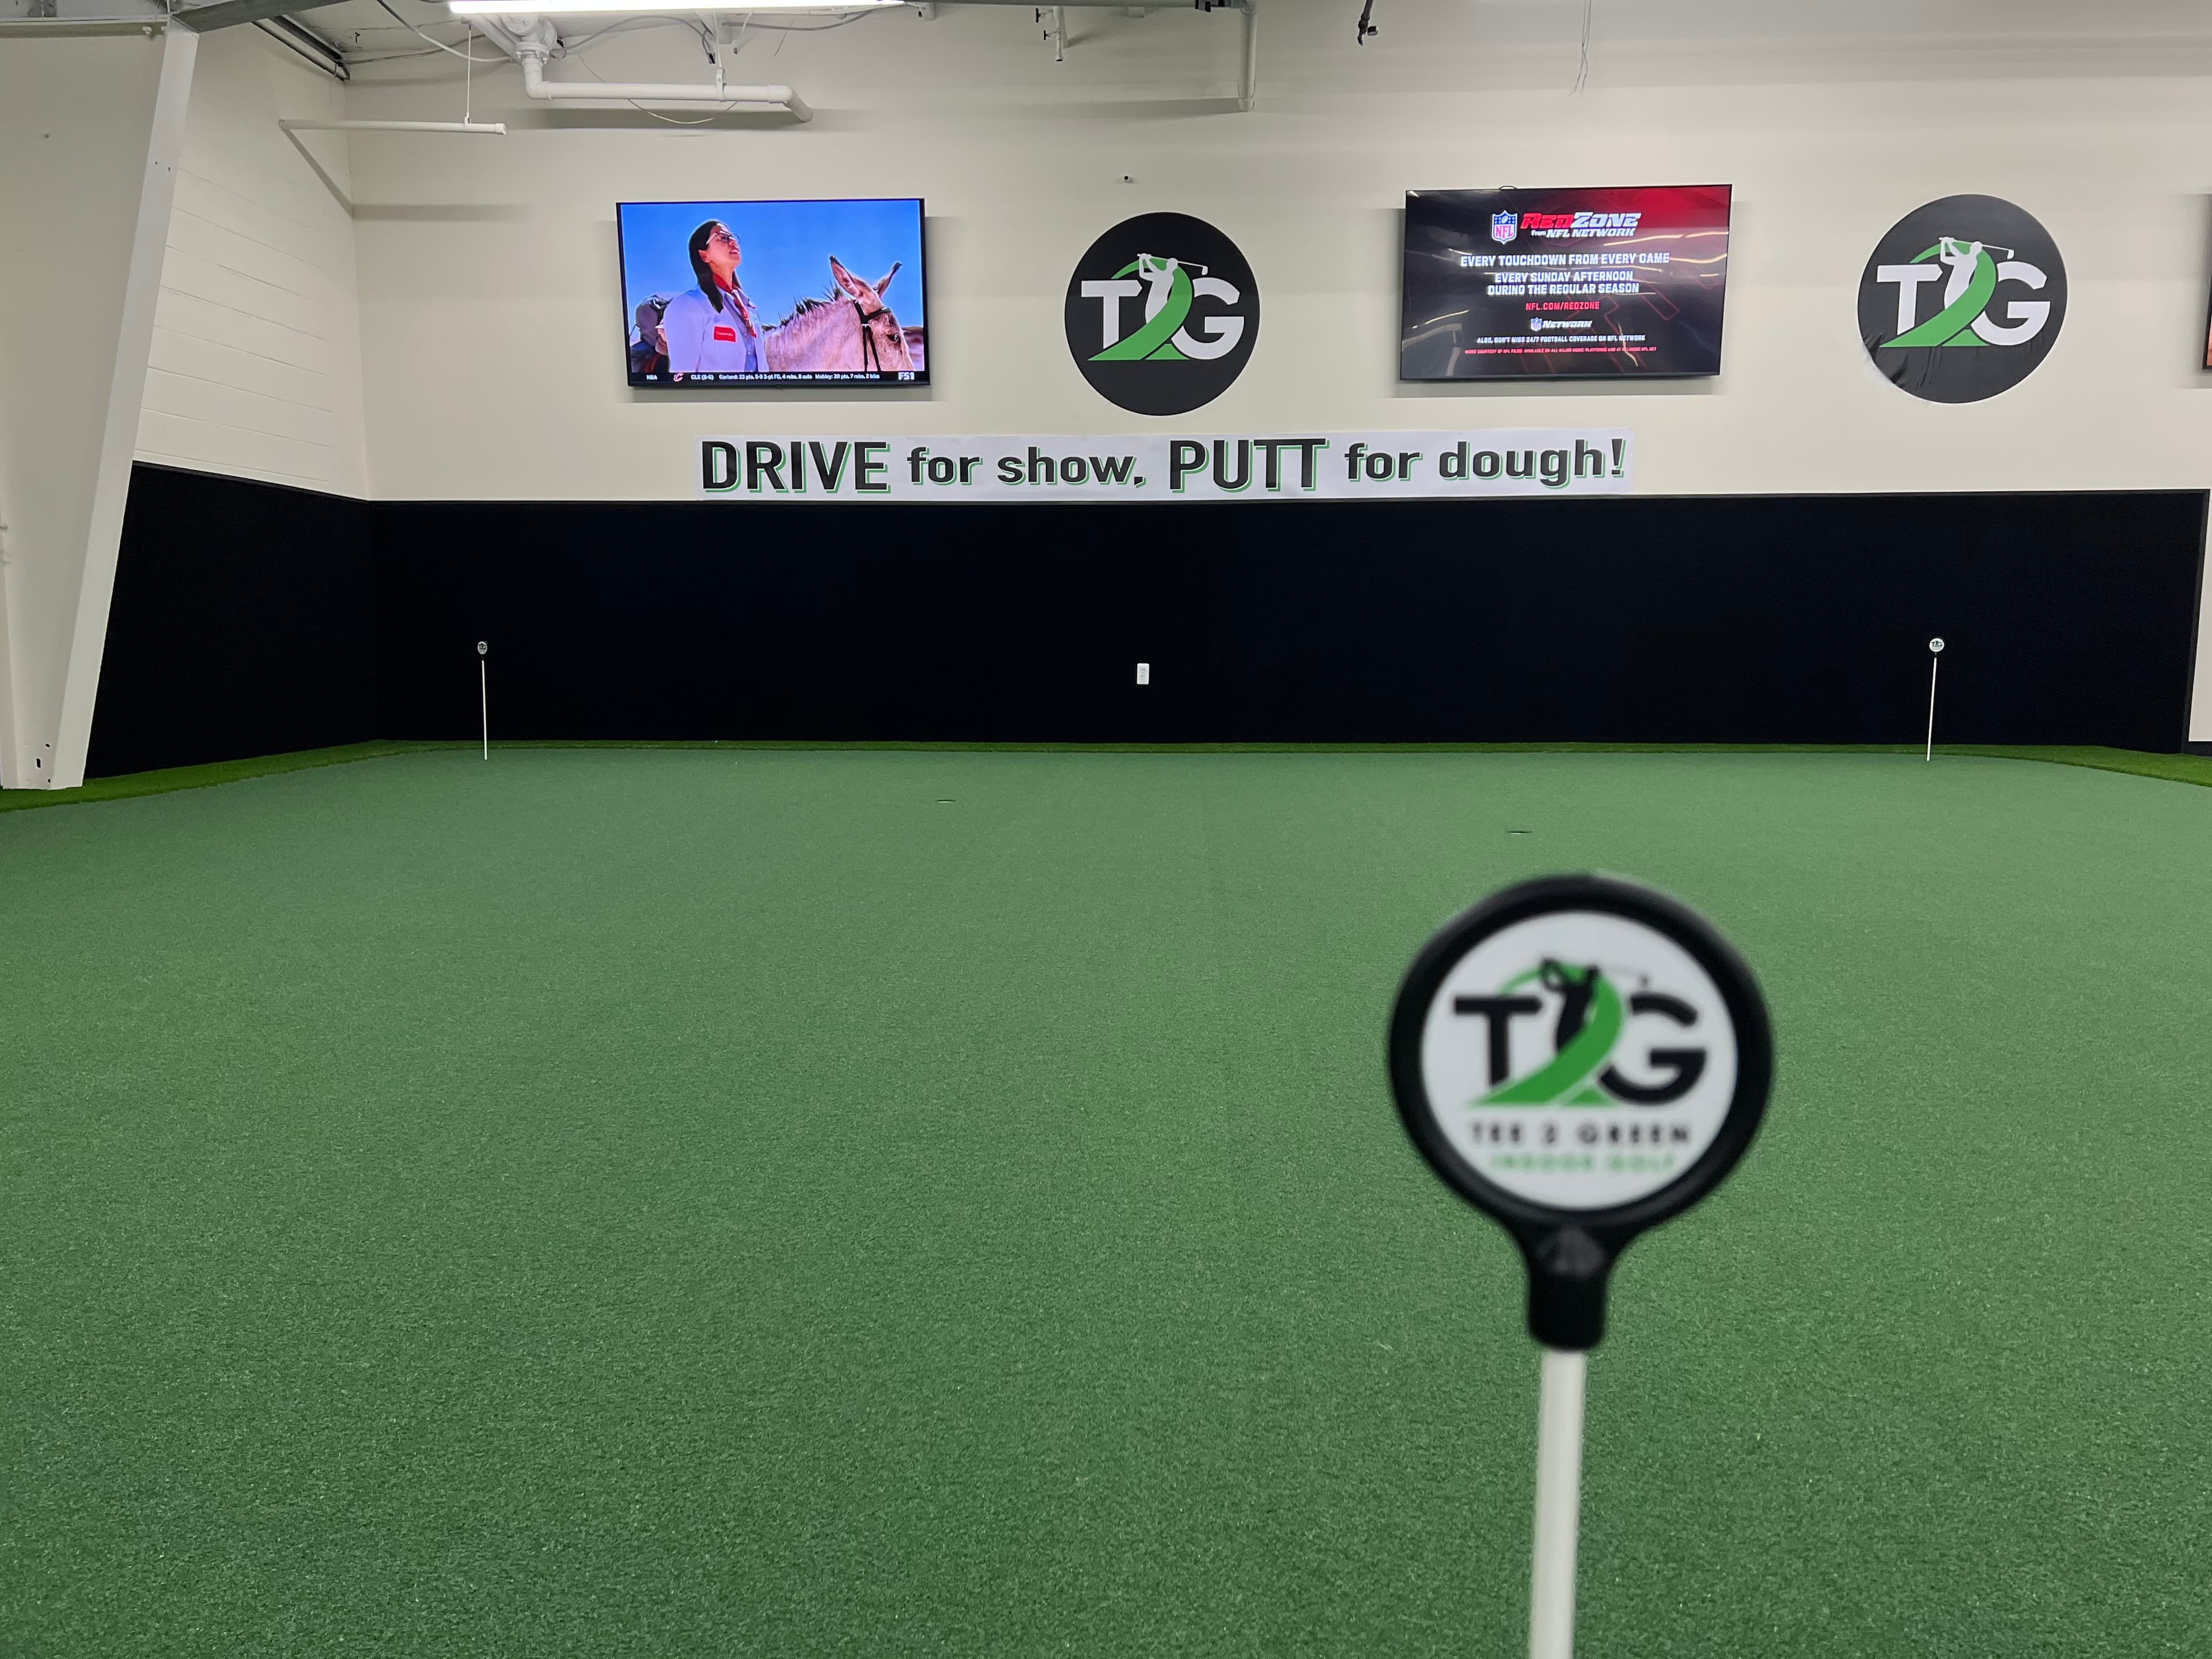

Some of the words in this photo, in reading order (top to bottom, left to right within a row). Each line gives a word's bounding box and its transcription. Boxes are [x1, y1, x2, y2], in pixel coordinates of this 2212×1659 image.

[1494, 225, 1513, 239] NFL
[1546, 229, 1570, 237] NFL
[1571, 228, 1636, 237] NETWORK
[1461, 255, 1496, 267] EVERY
[1498, 254, 1566, 266] TOUCHDOWN
[1569, 253, 1598, 265] FROM
[1601, 253, 1637, 264] EVERY
[1639, 253, 1670, 264] GAME
[1495, 272, 1527, 283] EVERY
[1530, 272, 1571, 282] SUNDAY
[1573, 271, 1633, 281] AFTERNOON
[1488, 285, 1525, 296] DURING
[1528, 284, 1547, 294] THE
[1549, 283, 1596, 294] REGULAR
[1598, 283, 1639, 293] SEASON
[1525, 302, 1600, 310] NFL.COM/REDZONE
[898, 372, 915, 380] FS1
[701, 441, 891, 494] DRIVE
[907, 446, 983, 486] for
[997, 446, 1146, 488] show,
[1169, 438, 1330, 493] PUTT
[1344, 442, 1422, 482] for
[1438, 438, 1626, 488] dough!
[1577, 1122, 1690, 1144] GREEN
